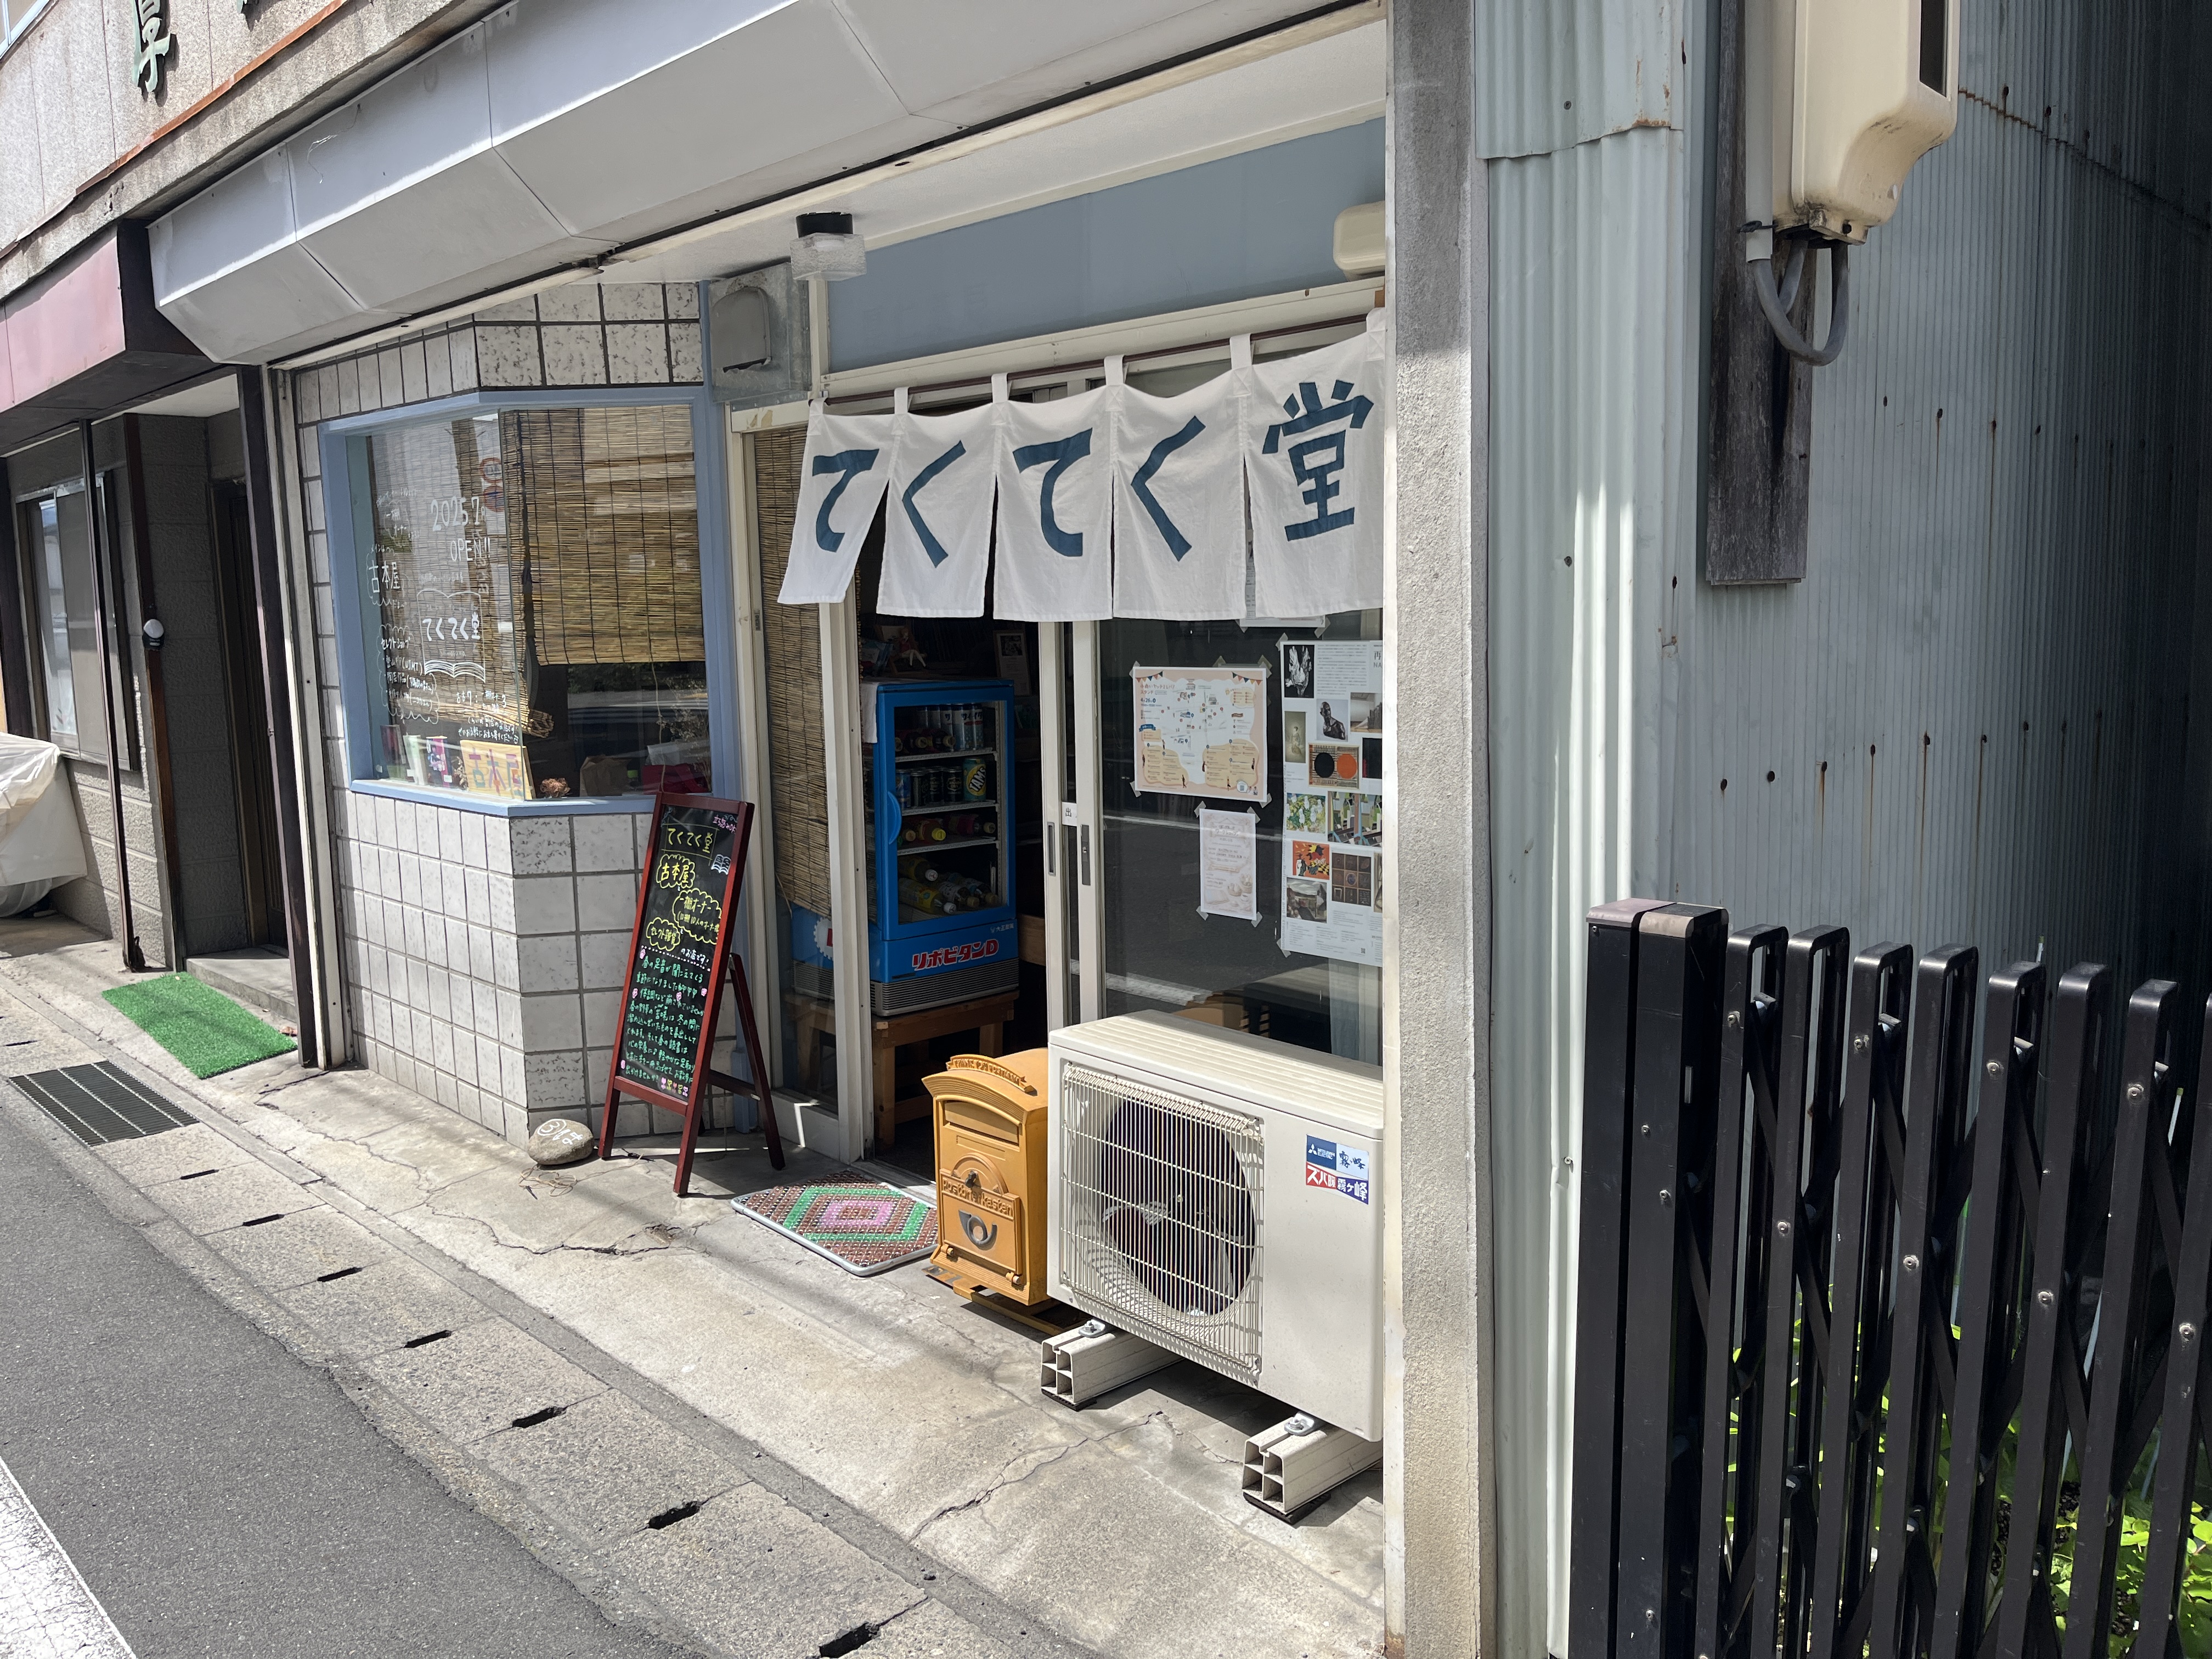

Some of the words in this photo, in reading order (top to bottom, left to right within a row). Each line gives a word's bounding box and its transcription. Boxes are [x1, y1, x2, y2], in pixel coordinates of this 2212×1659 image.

[812, 380, 1374, 568] てくてく堂
[450, 537, 491, 561] OPEN!!
[368, 560, 400, 593] 古本屋
[422, 611, 481, 642] てくてく堂
[469, 747, 524, 799] 古本屋
[668, 828, 713, 854] てくてく堂
[661, 862, 690, 883] 古本屋
[912, 939, 999, 971] リポビタンD
